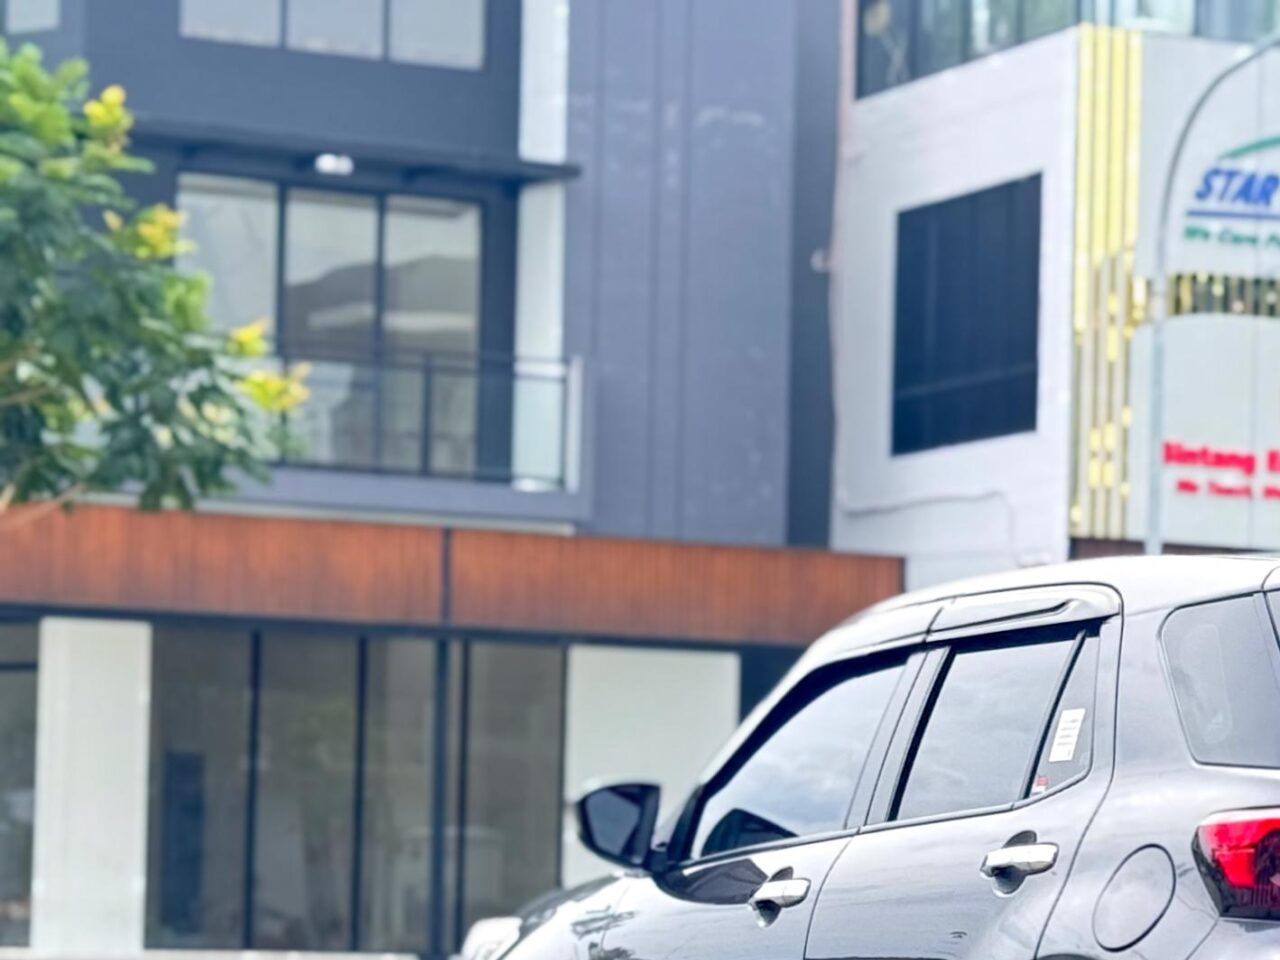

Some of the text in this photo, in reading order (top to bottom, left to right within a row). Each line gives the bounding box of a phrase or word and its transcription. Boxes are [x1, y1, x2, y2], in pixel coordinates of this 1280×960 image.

[1194, 166, 1280, 208] STAR
[1184, 224, 1212, 242] We
[1217, 227, 1261, 248] Care
